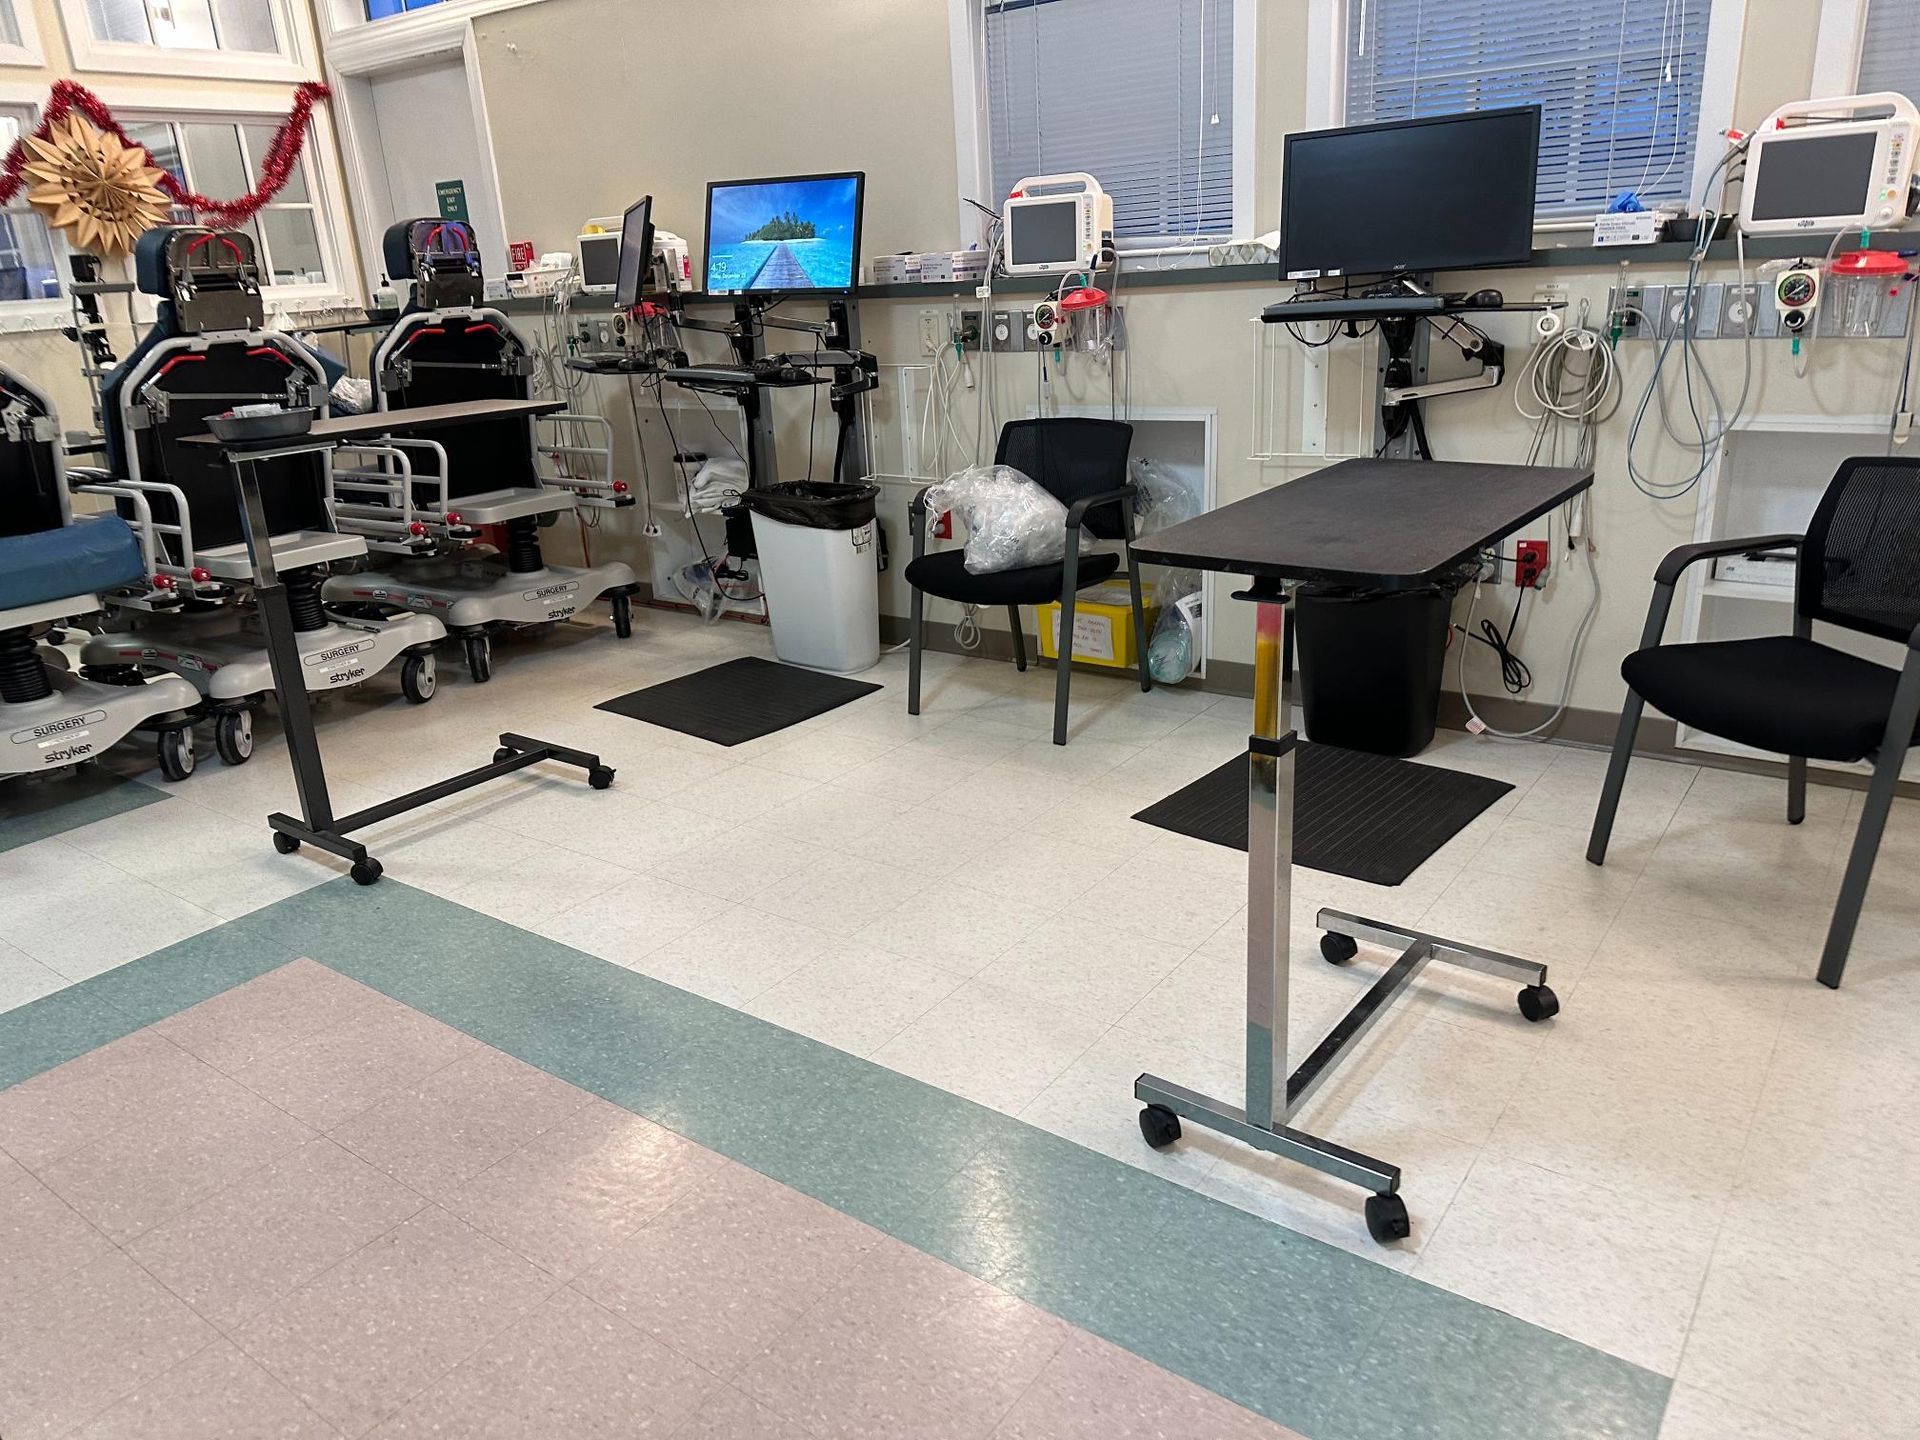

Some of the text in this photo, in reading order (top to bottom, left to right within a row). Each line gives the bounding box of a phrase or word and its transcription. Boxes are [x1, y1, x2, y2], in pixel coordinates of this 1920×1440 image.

[511, 247, 526, 260] FIRE
[710, 262, 727, 272] 4:19
[536, 585, 567, 597] SURGERY
[548, 606, 576, 619] stryker
[320, 644, 360, 661] SURGERY
[329, 667, 365, 684] stryker
[33, 716, 86, 737] SURGERY
[44, 743, 92, 764] stryker
